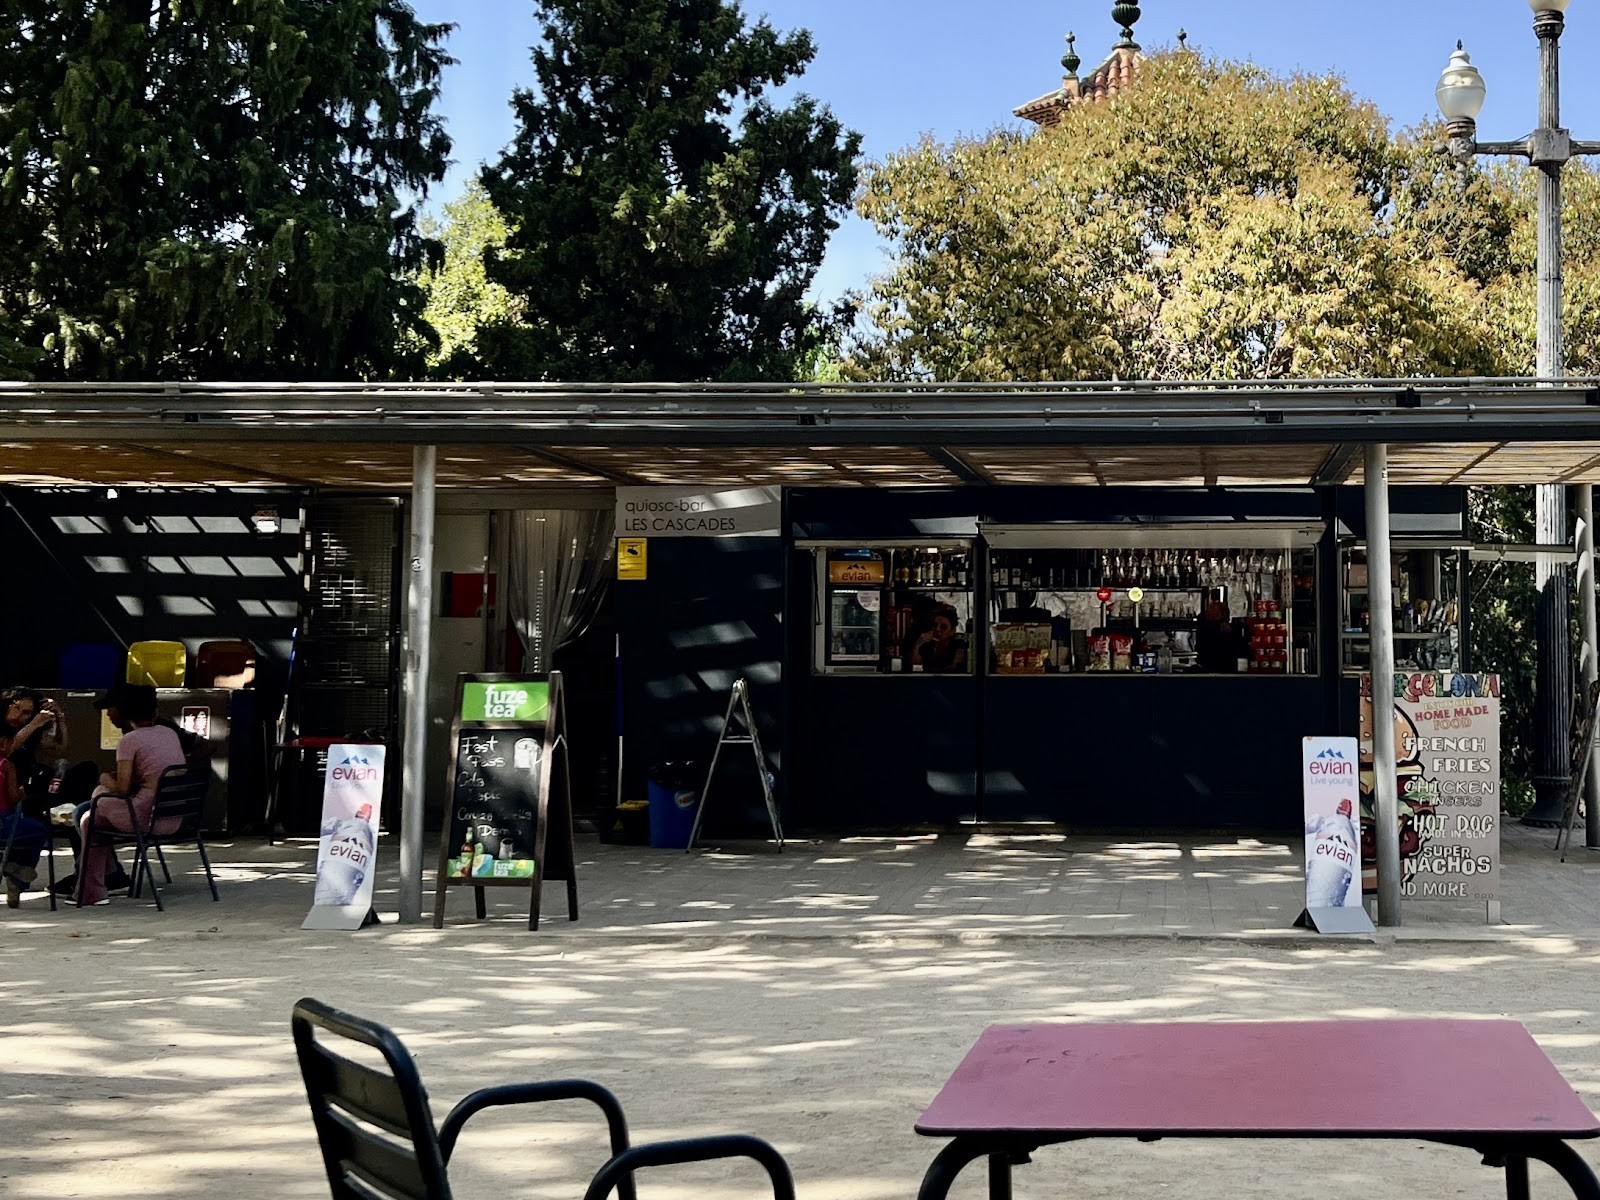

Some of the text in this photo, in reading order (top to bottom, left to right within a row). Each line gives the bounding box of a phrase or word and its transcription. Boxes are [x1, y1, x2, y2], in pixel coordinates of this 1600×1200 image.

[625, 499, 706, 514] quiosc-bar
[625, 518, 736, 531] LES CASCADES
[842, 570, 872, 581] evian
[485, 684, 528, 705] fuze
[484, 703, 517, 718] tea
[1415, 705, 1489, 721] HOME MADE
[1433, 717, 1472, 730] FOOD
[1405, 737, 1486, 752] FRENCH
[332, 766, 377, 780] evian
[1309, 759, 1353, 775] evian
[1432, 758, 1491, 773] FRIES
[1328, 776, 1353, 787] young
[1404, 779, 1495, 795] CHICKEN
[1418, 796, 1483, 807] FINGERS
[1413, 814, 1494, 833] HOT DOG
[1450, 829, 1462, 839] IN
[329, 844, 368, 868] evian
[1316, 843, 1354, 866] evian
[1422, 845, 1472, 859] SUPER
[1403, 856, 1492, 876] NACHOS
[1400, 881, 1417, 897] ND
[1422, 881, 1469, 897] MORE
